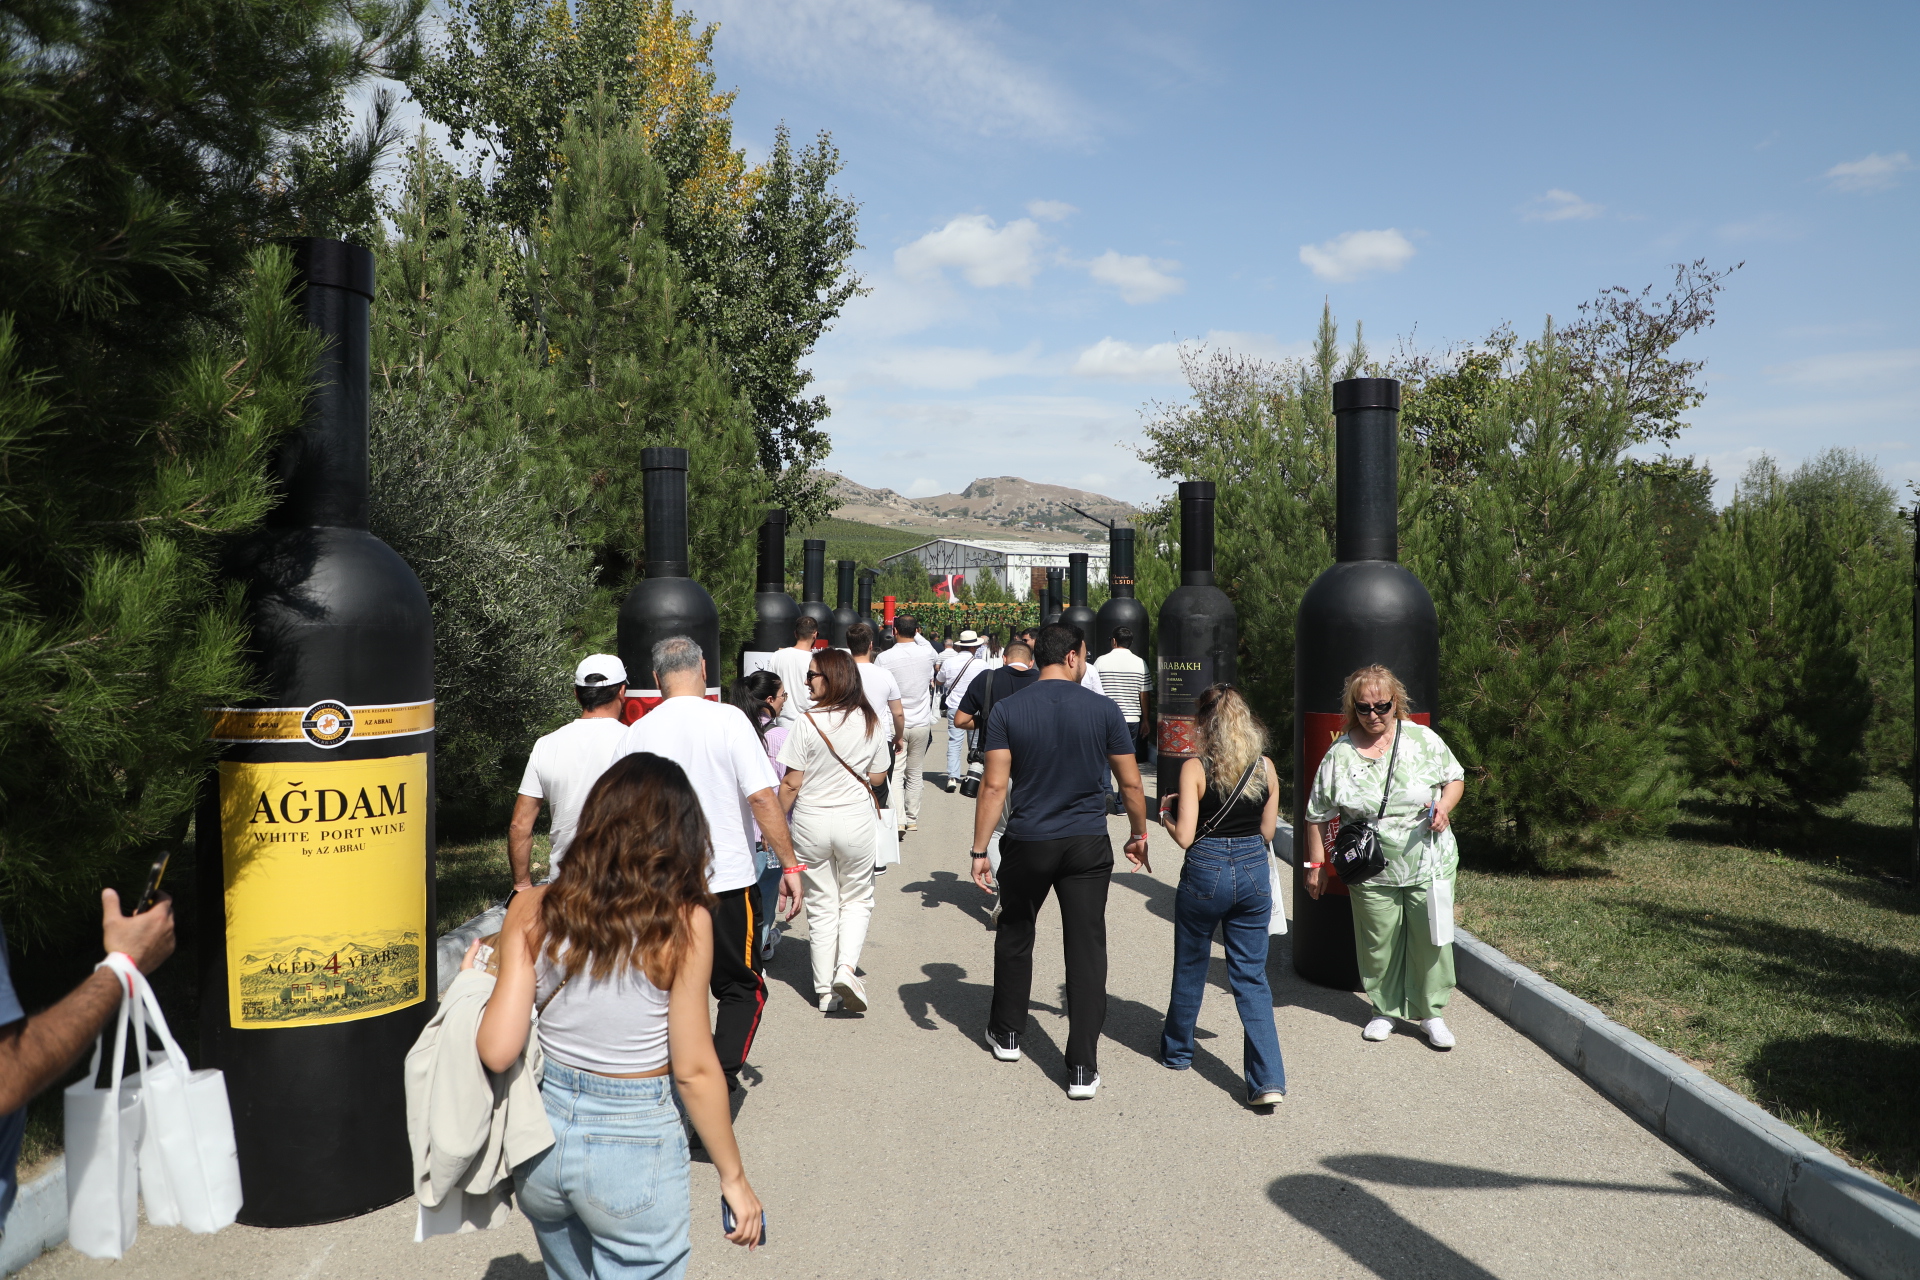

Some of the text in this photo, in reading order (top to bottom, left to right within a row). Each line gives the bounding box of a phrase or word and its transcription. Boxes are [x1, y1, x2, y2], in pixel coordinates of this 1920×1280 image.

[250, 781, 408, 824] AĞDAM
[254, 822, 406, 843] WHITE PORT WINE
[302, 843, 366, 858] by AZ ABRAU
[264, 947, 400, 975] AGED 4 YEARS
[291, 973, 379, 991] RESERVE
[352, 986, 388, 998] WINERY
